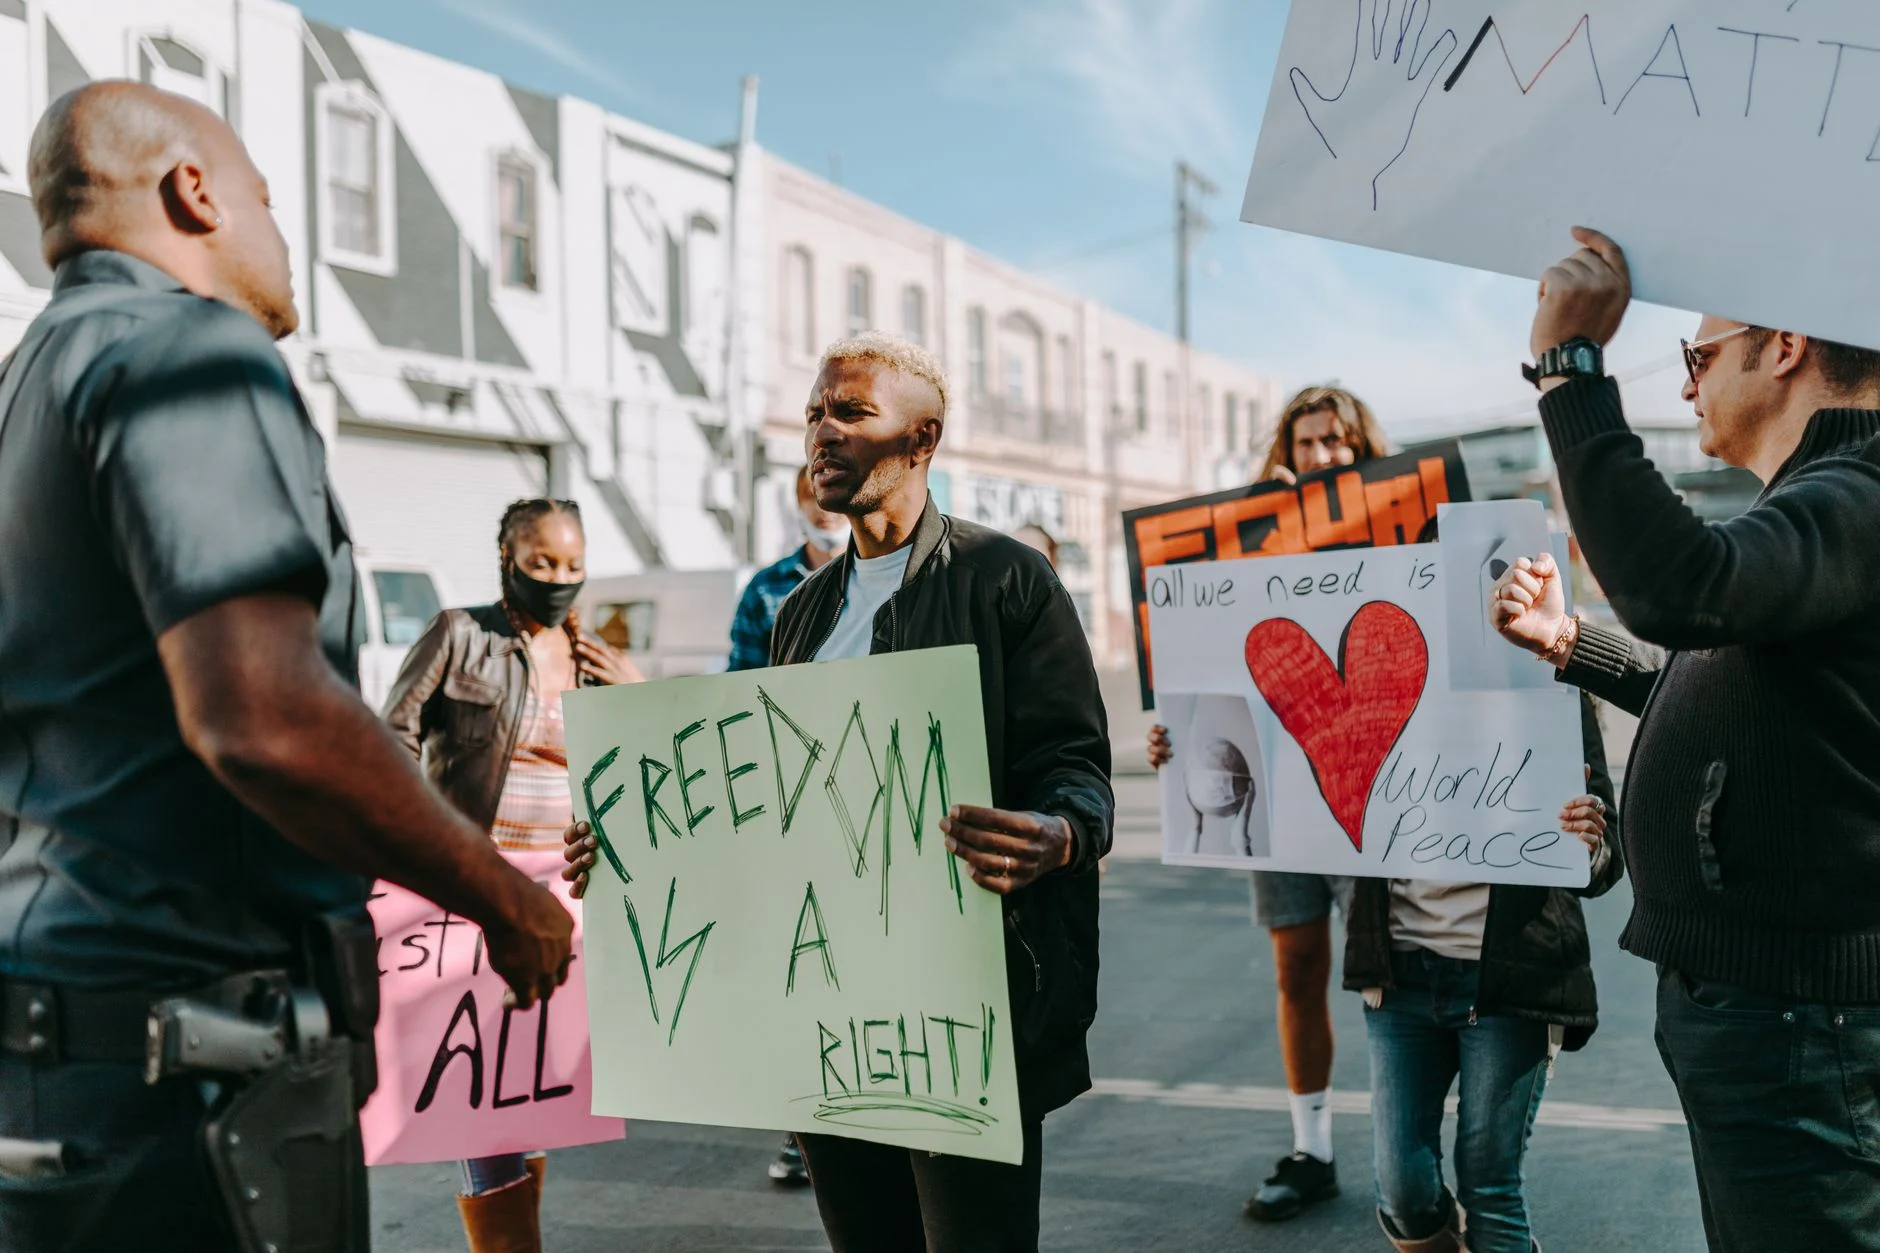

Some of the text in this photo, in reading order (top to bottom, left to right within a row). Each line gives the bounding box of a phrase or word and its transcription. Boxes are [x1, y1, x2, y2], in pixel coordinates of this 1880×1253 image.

[1442, 13, 1880, 162] MATT
[1150, 558, 1437, 609] all we need is
[581, 684, 964, 937] FREEDOM
[1376, 742, 1541, 813] World
[1381, 804, 1575, 871] Peace
[622, 876, 717, 1047] IS
[785, 881, 841, 998] A
[414, 989, 574, 1113] ALL
[816, 1002, 996, 1106] RIGHT!
